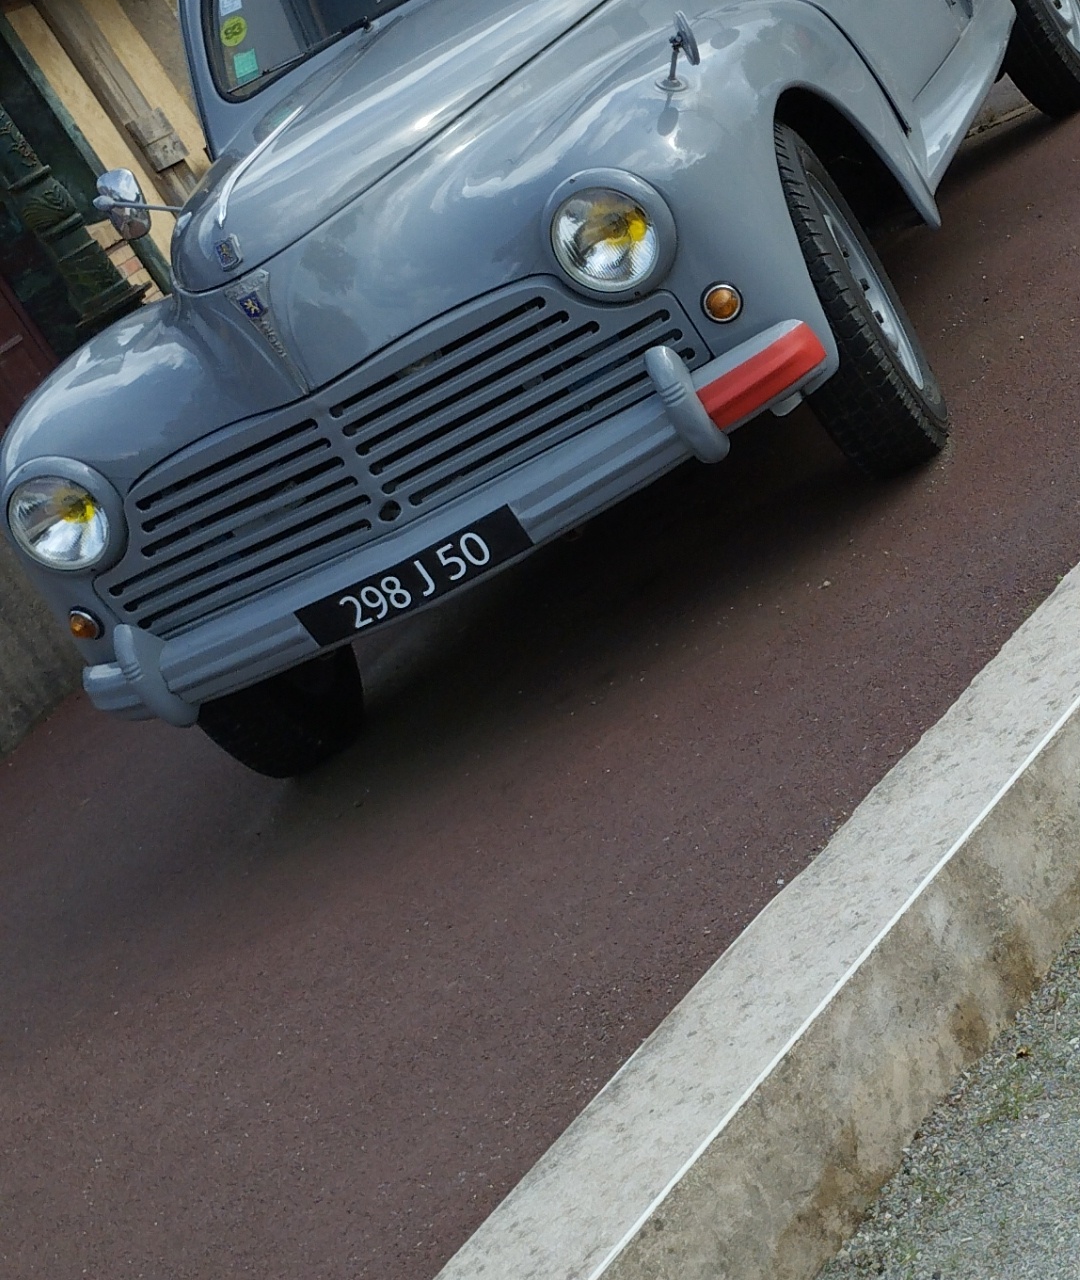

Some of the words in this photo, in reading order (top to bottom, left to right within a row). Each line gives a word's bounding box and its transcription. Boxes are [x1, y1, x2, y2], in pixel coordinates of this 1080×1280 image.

[339, 576, 411, 629] 298
[413, 560, 436, 598] J
[437, 532, 490, 580] 50
